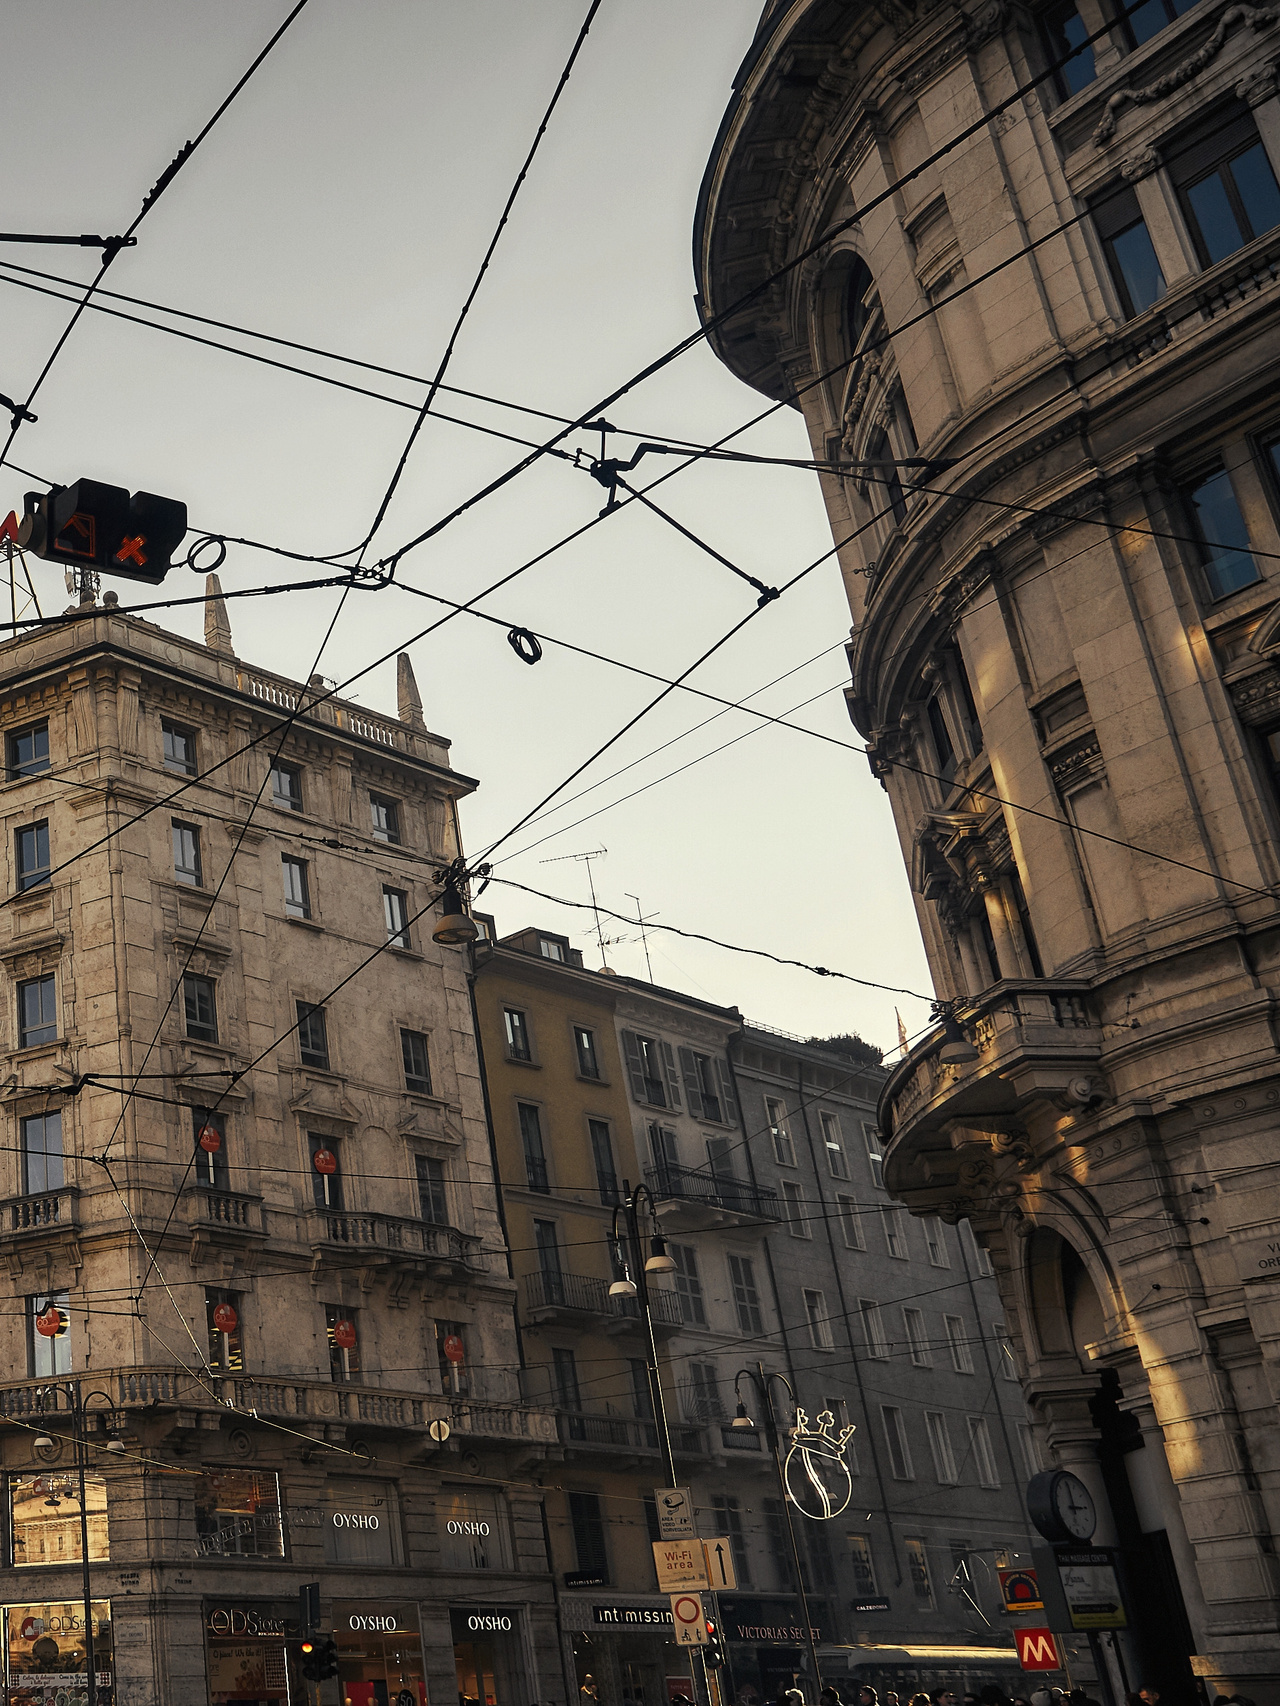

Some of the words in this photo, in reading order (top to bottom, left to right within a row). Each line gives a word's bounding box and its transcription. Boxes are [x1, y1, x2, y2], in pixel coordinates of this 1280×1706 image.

[1267, 1242, 1280, 1253] VI
[333, 1513, 379, 1530] OYSHO
[447, 1520, 489, 1537] OYSHO
[664, 1551, 692, 1561] Wi-Fi
[667, 1562, 693, 1570] area
[349, 1615, 397, 1631] OYSHO
[599, 1608, 674, 1623] intimissim
[468, 1616, 511, 1631] OYSHO
[737, 1624, 788, 1640] VICTORIA'S
[789, 1626, 821, 1640] SECET
[1023, 1636, 1056, 1662] M
